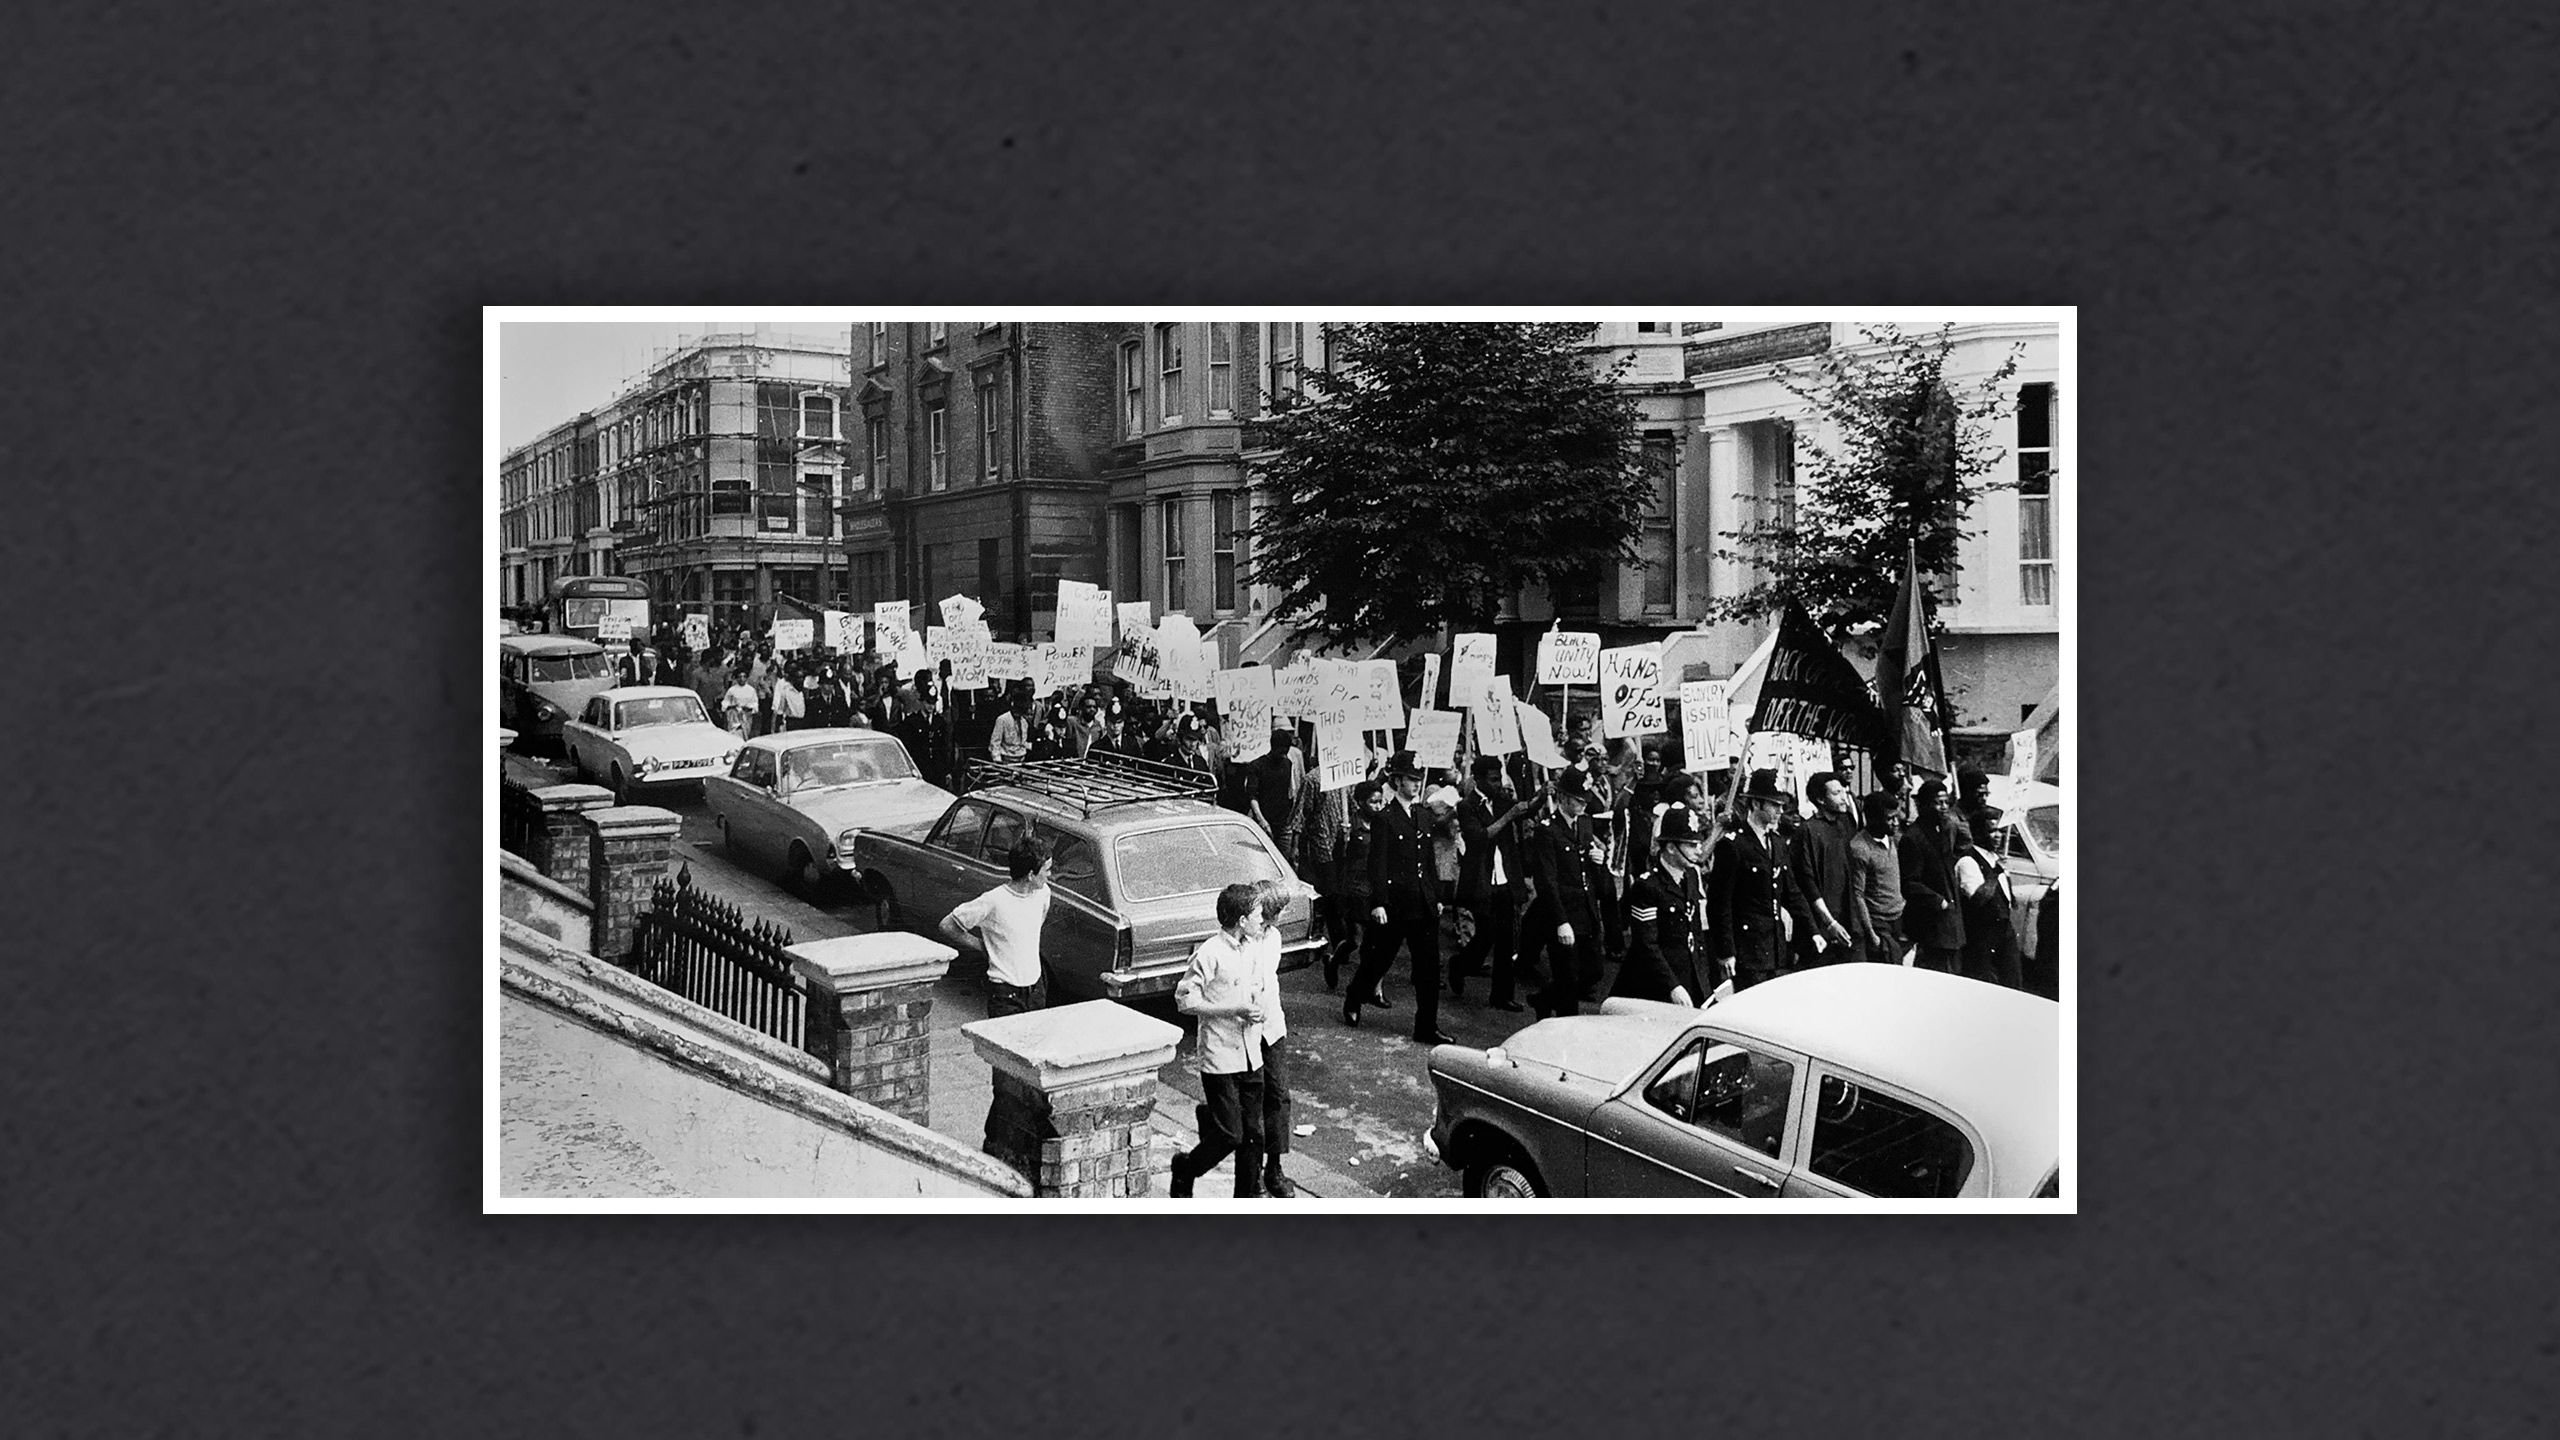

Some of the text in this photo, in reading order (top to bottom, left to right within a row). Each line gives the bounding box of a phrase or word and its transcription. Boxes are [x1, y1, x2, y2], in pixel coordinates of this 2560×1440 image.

[1555, 634, 1588, 646] BLACK
[1556, 647, 1594, 663] UNITY
[1048, 661, 1080, 671] TO THE
[1549, 663, 1593, 679] NOW!
[1615, 684, 1653, 709] OFF
[1683, 684, 1725, 704] SLAVERY
[1320, 709, 1346, 729] THIS
[1762, 697, 1796, 730] OVER
[1794, 700, 1828, 735] THE
[1686, 725, 1727, 760] ALIVE
[1322, 746, 1341, 762] THE
[1326, 758, 1363, 783] TIME
